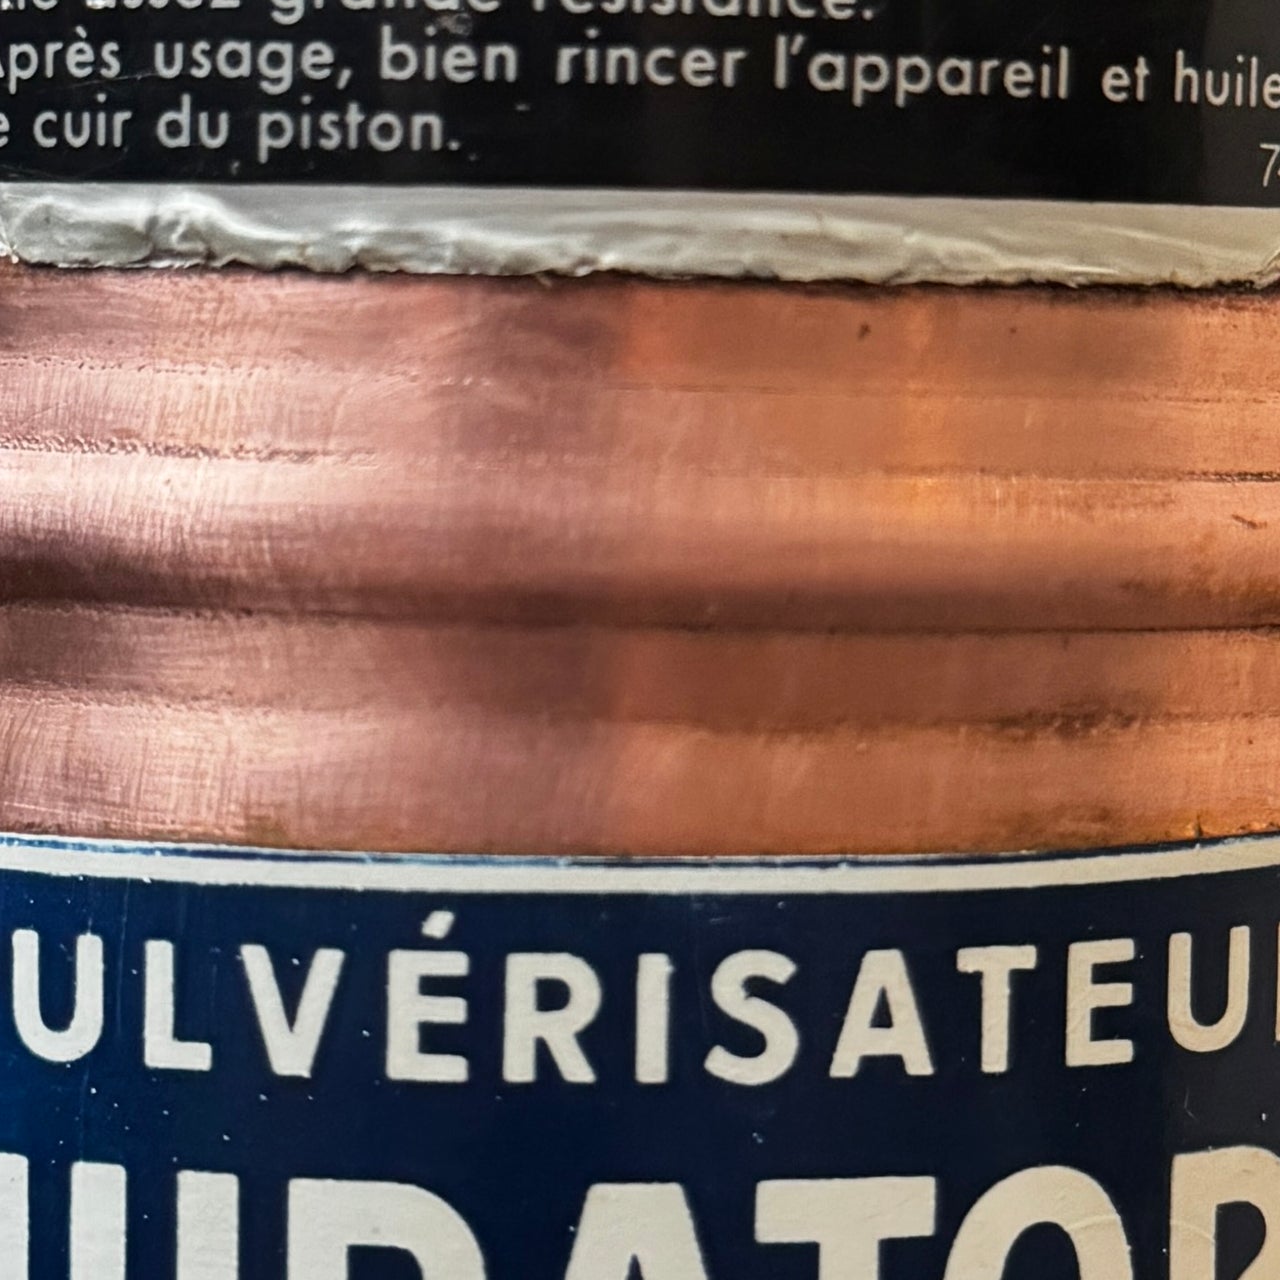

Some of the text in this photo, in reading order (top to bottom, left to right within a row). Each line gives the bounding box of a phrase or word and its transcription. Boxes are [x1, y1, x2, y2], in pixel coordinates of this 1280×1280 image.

[155, 41, 351, 94] usage,
[381, 25, 516, 82] bien
[558, 29, 746, 86] rincer
[776, 35, 1068, 106] l'appareil
[1102, 50, 1149, 101] et
[34, 99, 131, 147] cuir
[157, 94, 228, 148] du
[259, 103, 458, 163] piston.
